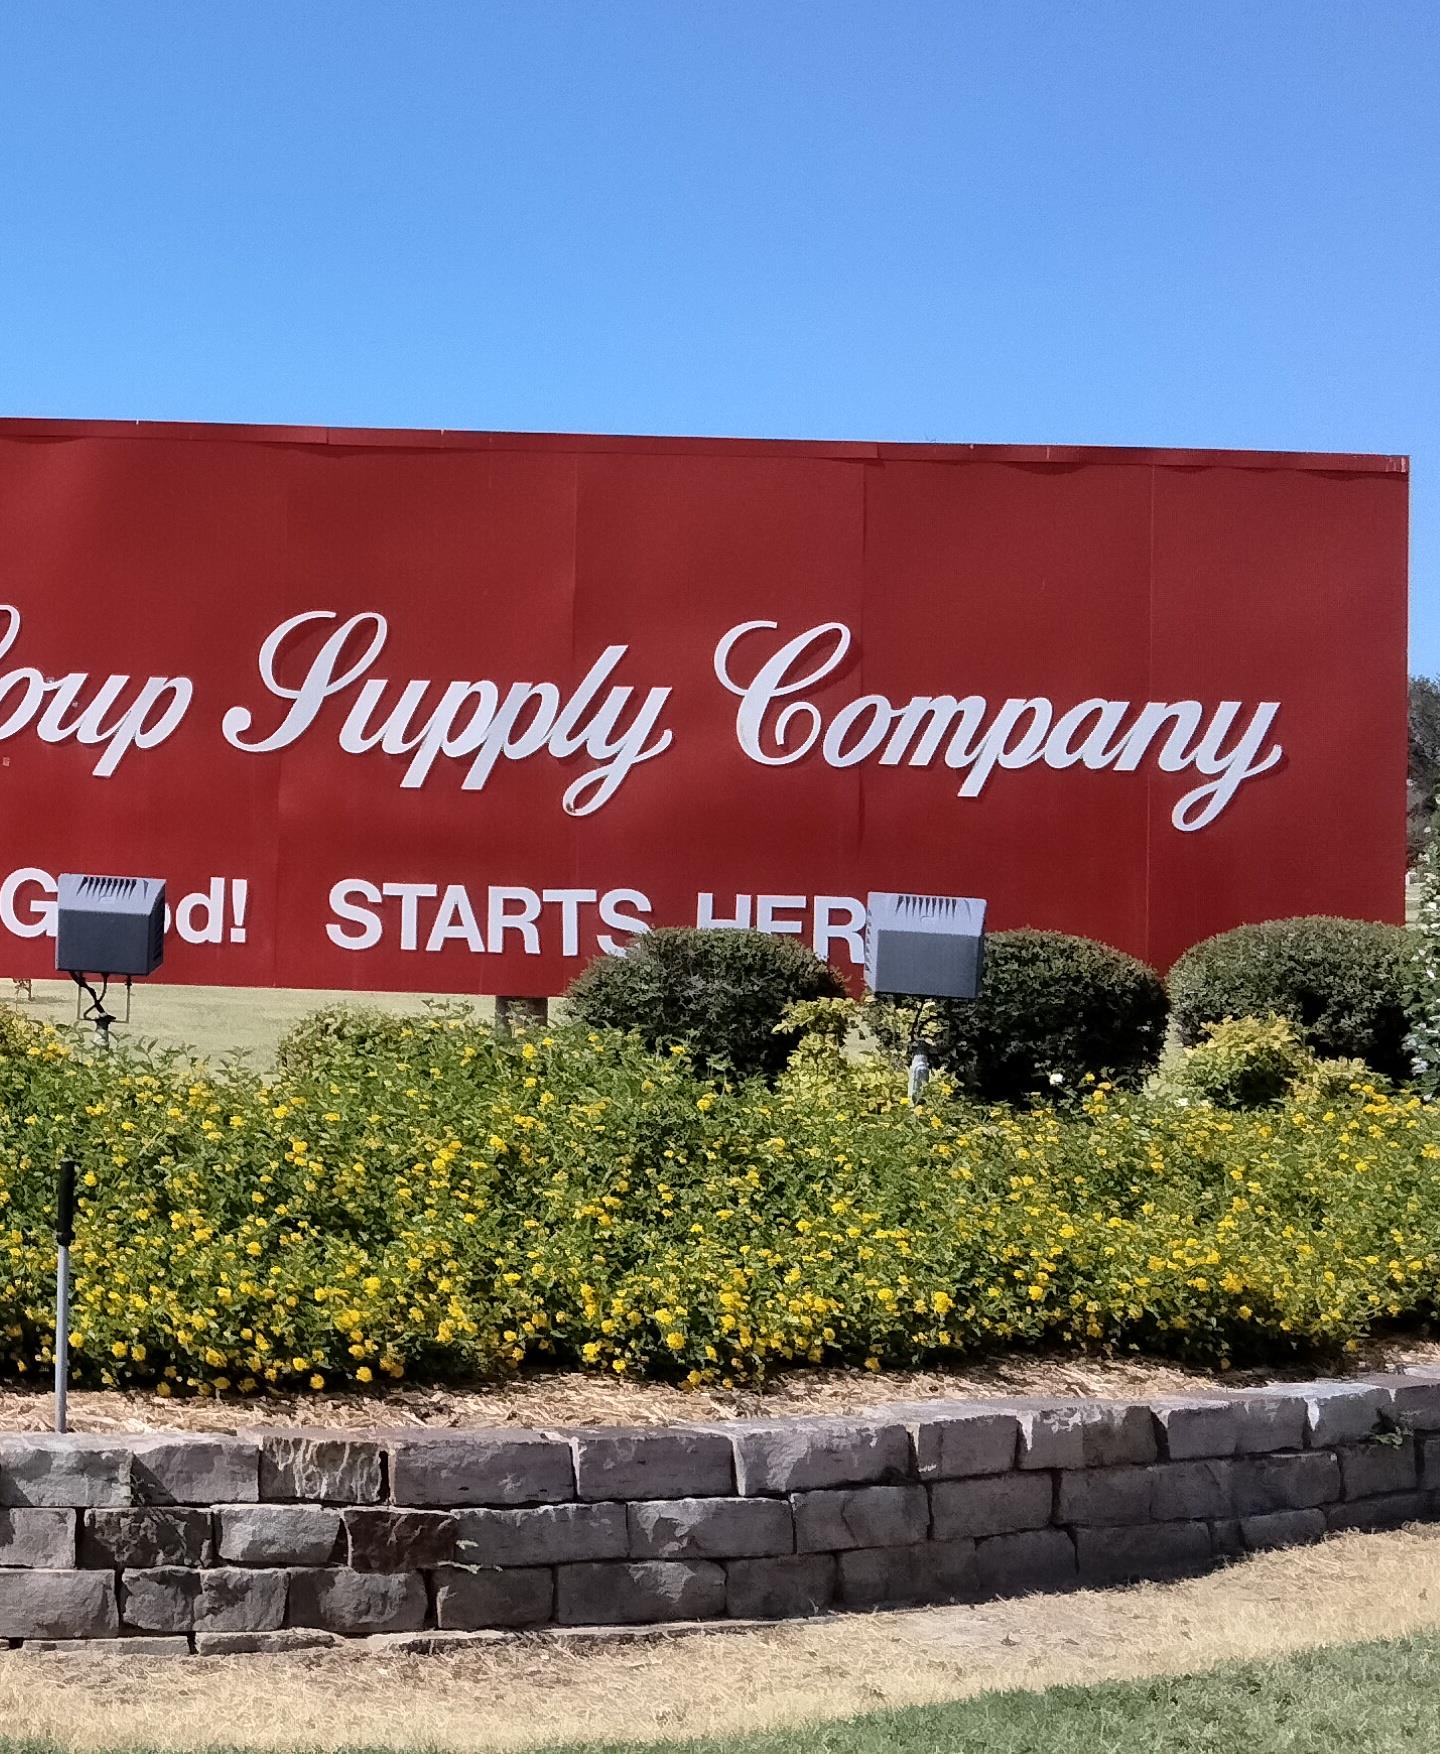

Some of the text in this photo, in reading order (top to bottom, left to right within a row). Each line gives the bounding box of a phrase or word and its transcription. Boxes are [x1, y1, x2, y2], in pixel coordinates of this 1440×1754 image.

[222, 611, 673, 816] Supply
[714, 620, 1282, 831] Company
[325, 878, 655, 959] STARTS
[695, 892, 867, 964] HER
